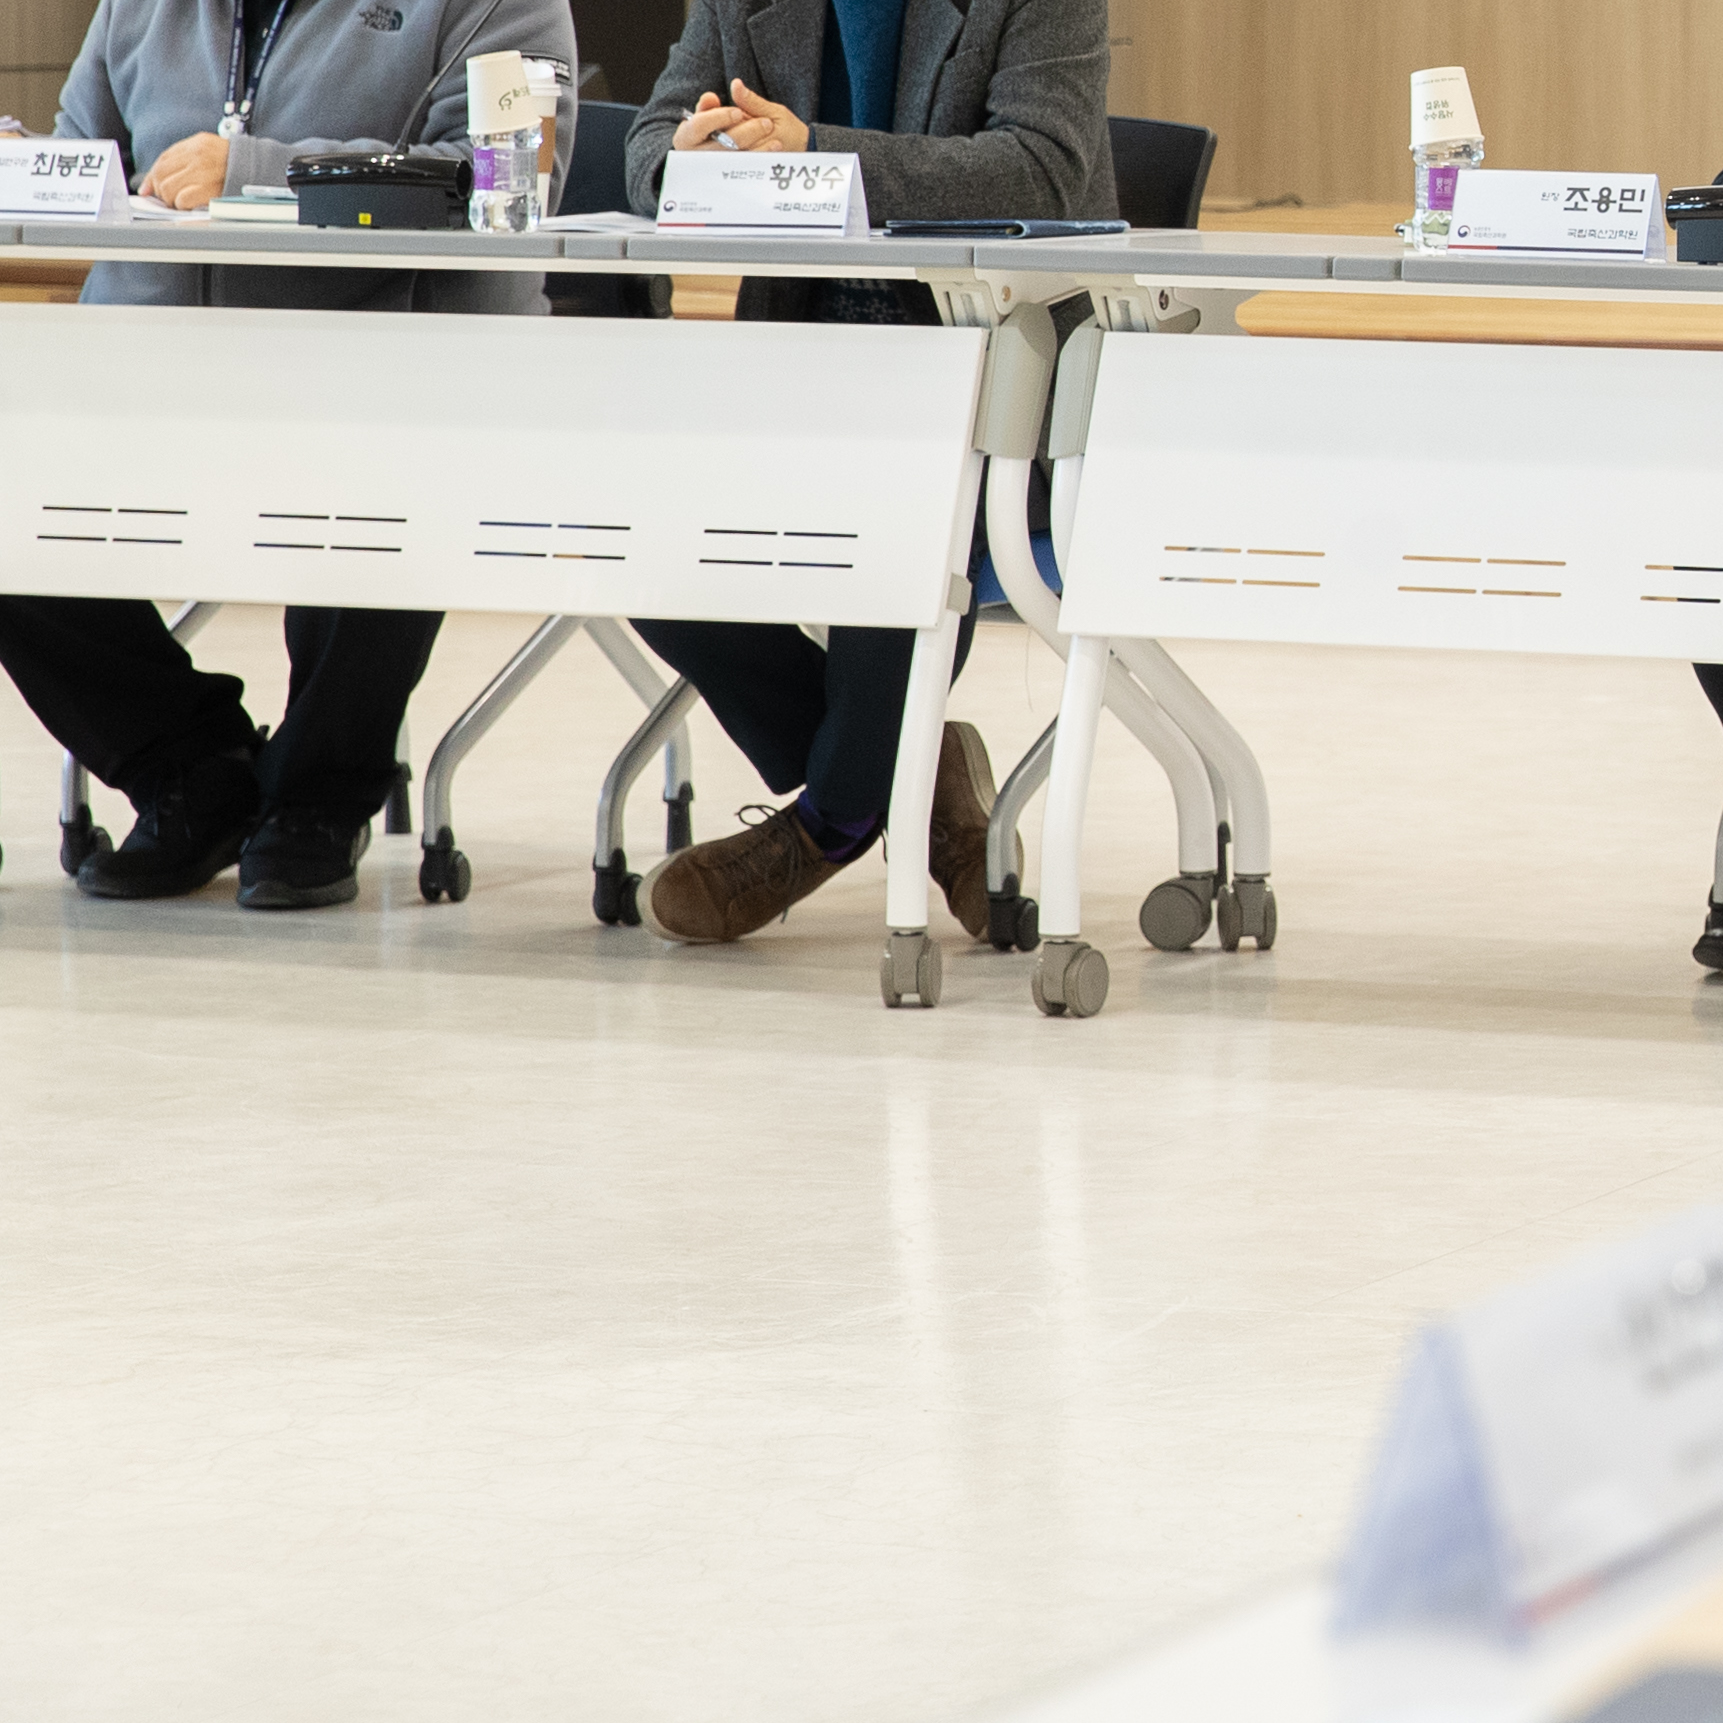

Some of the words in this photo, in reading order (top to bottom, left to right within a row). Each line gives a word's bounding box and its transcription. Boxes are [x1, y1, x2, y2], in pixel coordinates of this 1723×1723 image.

[30, 152, 105, 178] 최봉환
[769, 163, 845, 191] 황성수
[1540, 191, 1561, 202] 원장
[1563, 186, 1646, 214] 조용민
[1567, 228, 1639, 241] 국립축산과학원
